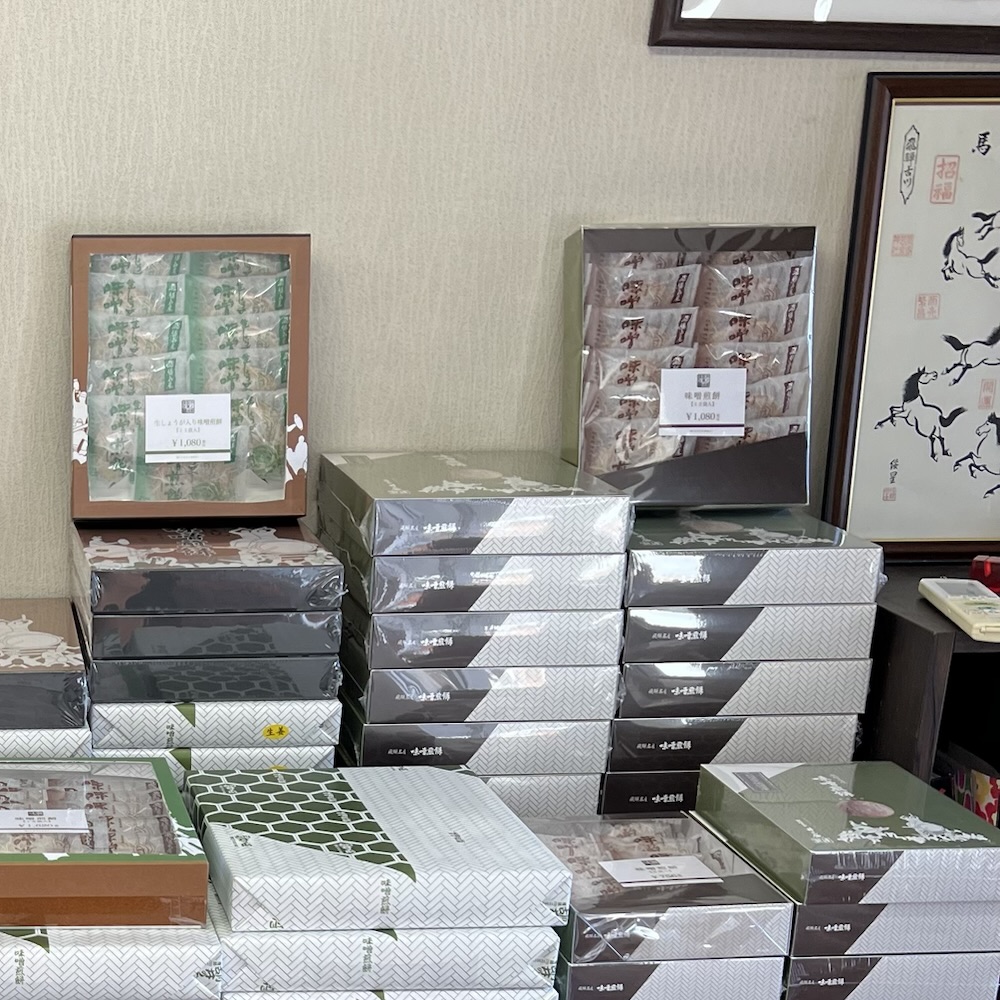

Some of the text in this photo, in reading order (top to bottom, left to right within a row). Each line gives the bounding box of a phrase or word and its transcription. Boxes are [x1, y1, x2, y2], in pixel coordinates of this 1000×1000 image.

[975, 131, 992, 156] 馬
[684, 391, 721, 400] 味噌煎餅
[265, 726, 286, 736] 生姜
